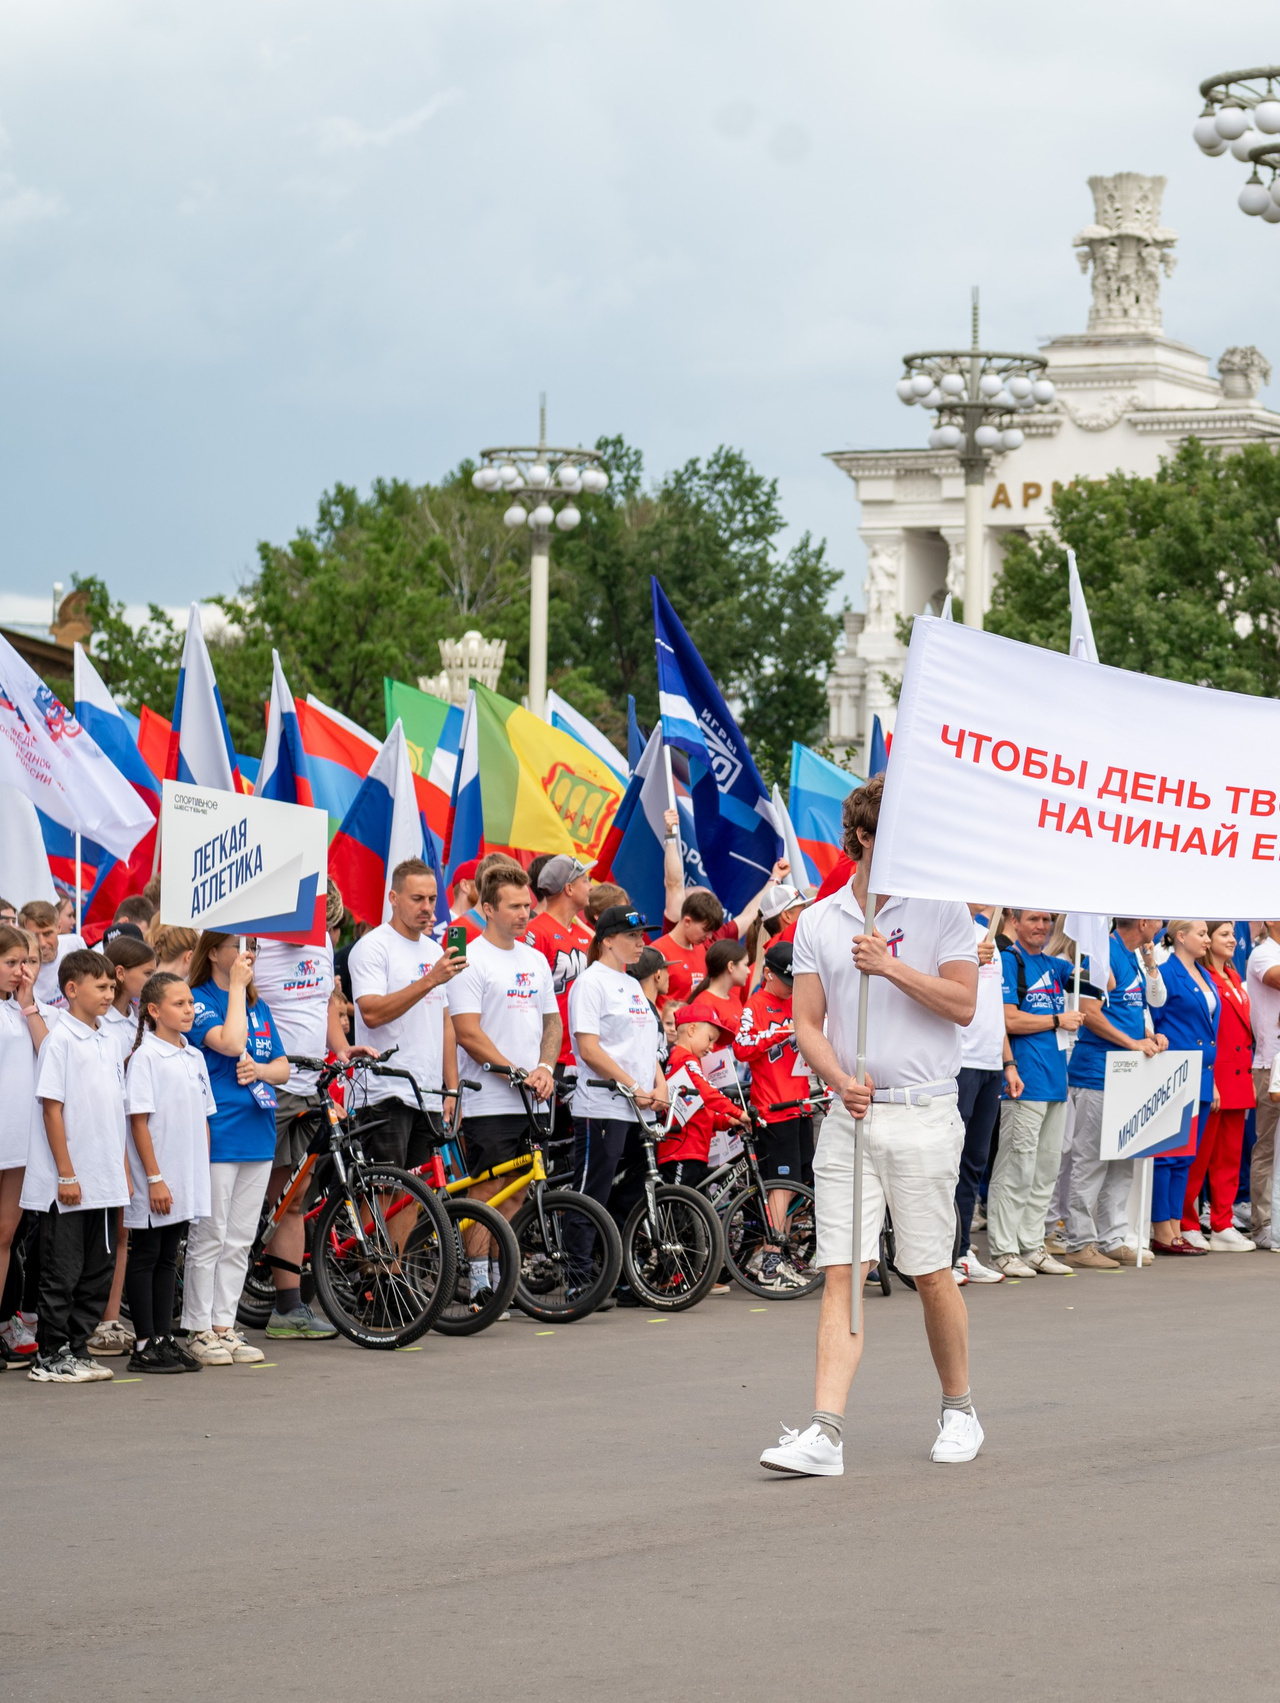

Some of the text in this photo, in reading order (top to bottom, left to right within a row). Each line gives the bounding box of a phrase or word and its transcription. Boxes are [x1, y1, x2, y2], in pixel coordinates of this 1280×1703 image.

[701, 708, 737, 755] ИГРЫ
[941, 725, 1088, 790] ЧТОБЫ
[1097, 767, 1210, 809] ДЕНЬ
[174, 794, 218, 810] СПОРТИВНОЕ
[174, 804, 208, 815] ШЕСТВИЕ
[1039, 799, 1239, 858] НАЧИНАЙ
[191, 817, 247, 882] ЛЕГКАЯ
[190, 844, 263, 919] АТЛЕТИКА
[1118, 1059, 1188, 1153] МНОГОБОРЬЕ ГТО
